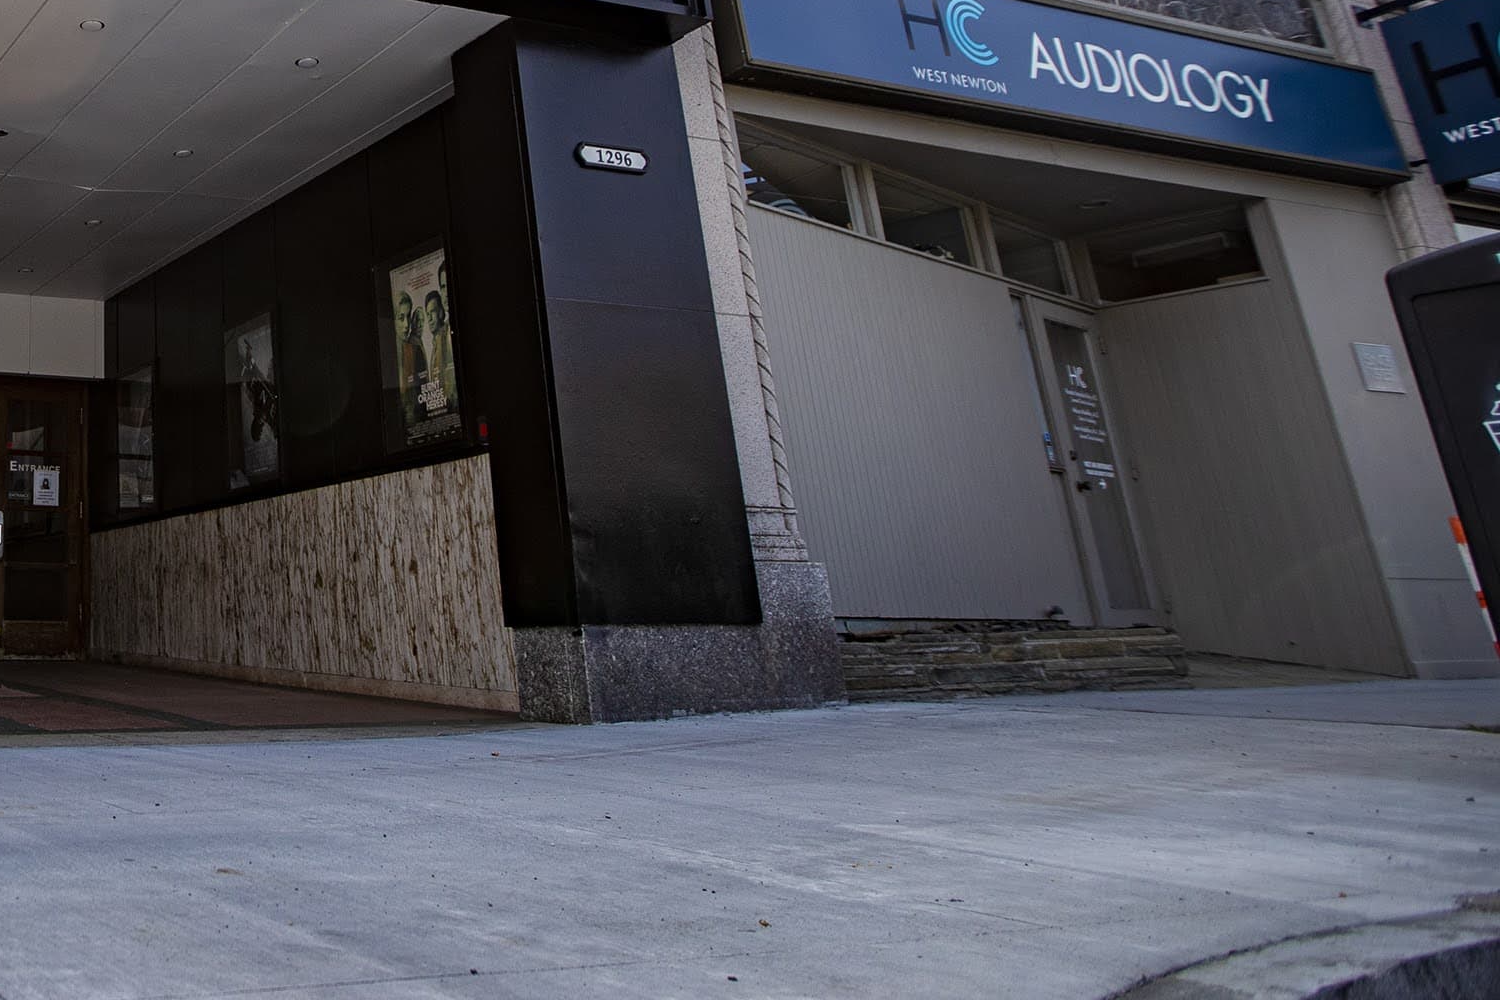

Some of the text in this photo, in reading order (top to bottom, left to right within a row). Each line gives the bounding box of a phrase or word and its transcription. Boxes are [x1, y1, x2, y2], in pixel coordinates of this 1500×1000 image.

[912, 65, 1008, 95] WEST NEWTON
[1030, 32, 1274, 122] AUDIOLOGY
[1411, 21, 1500, 115] H
[1442, 117, 1500, 143] WEST
[596, 149, 632, 167] 1296
